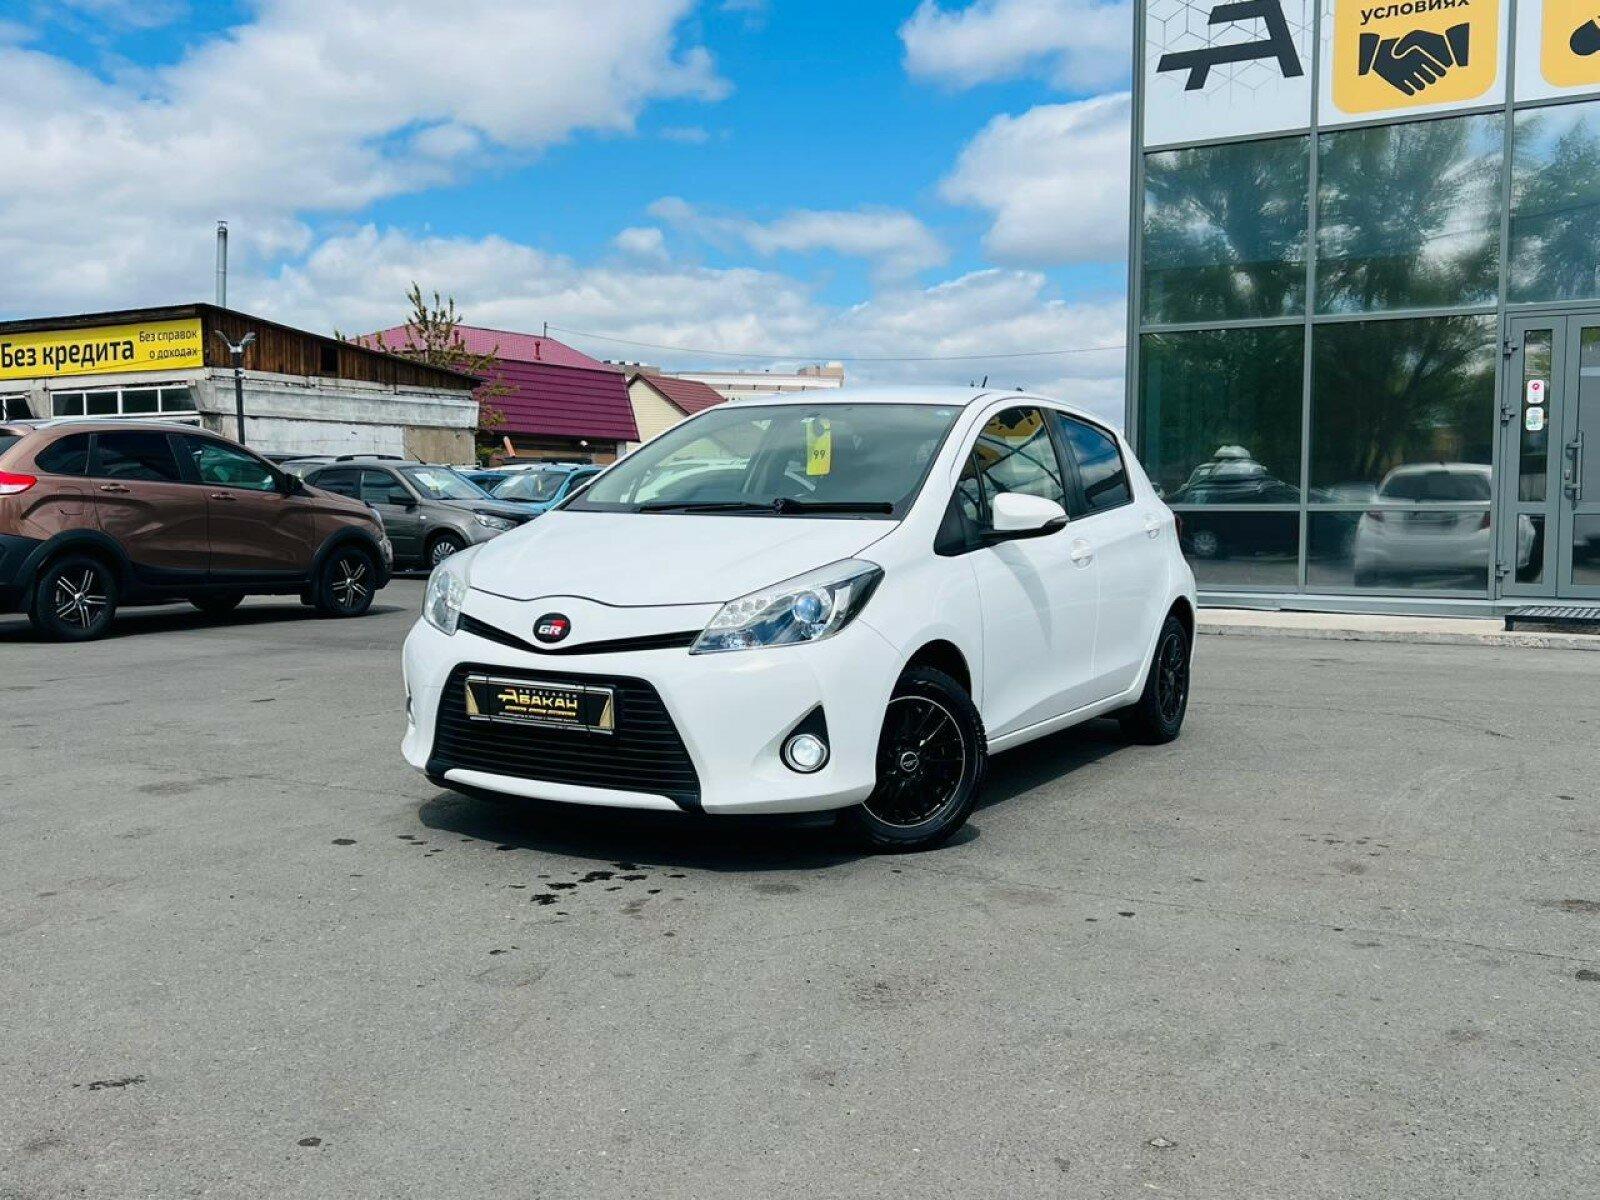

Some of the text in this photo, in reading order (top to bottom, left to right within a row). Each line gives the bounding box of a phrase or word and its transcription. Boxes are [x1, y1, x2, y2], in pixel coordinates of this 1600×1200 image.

[139, 330, 197, 343] Без справок
[1, 340, 135, 371] Без кредита
[149, 348, 198, 360] о доходах
[813, 449, 826, 460] 99
